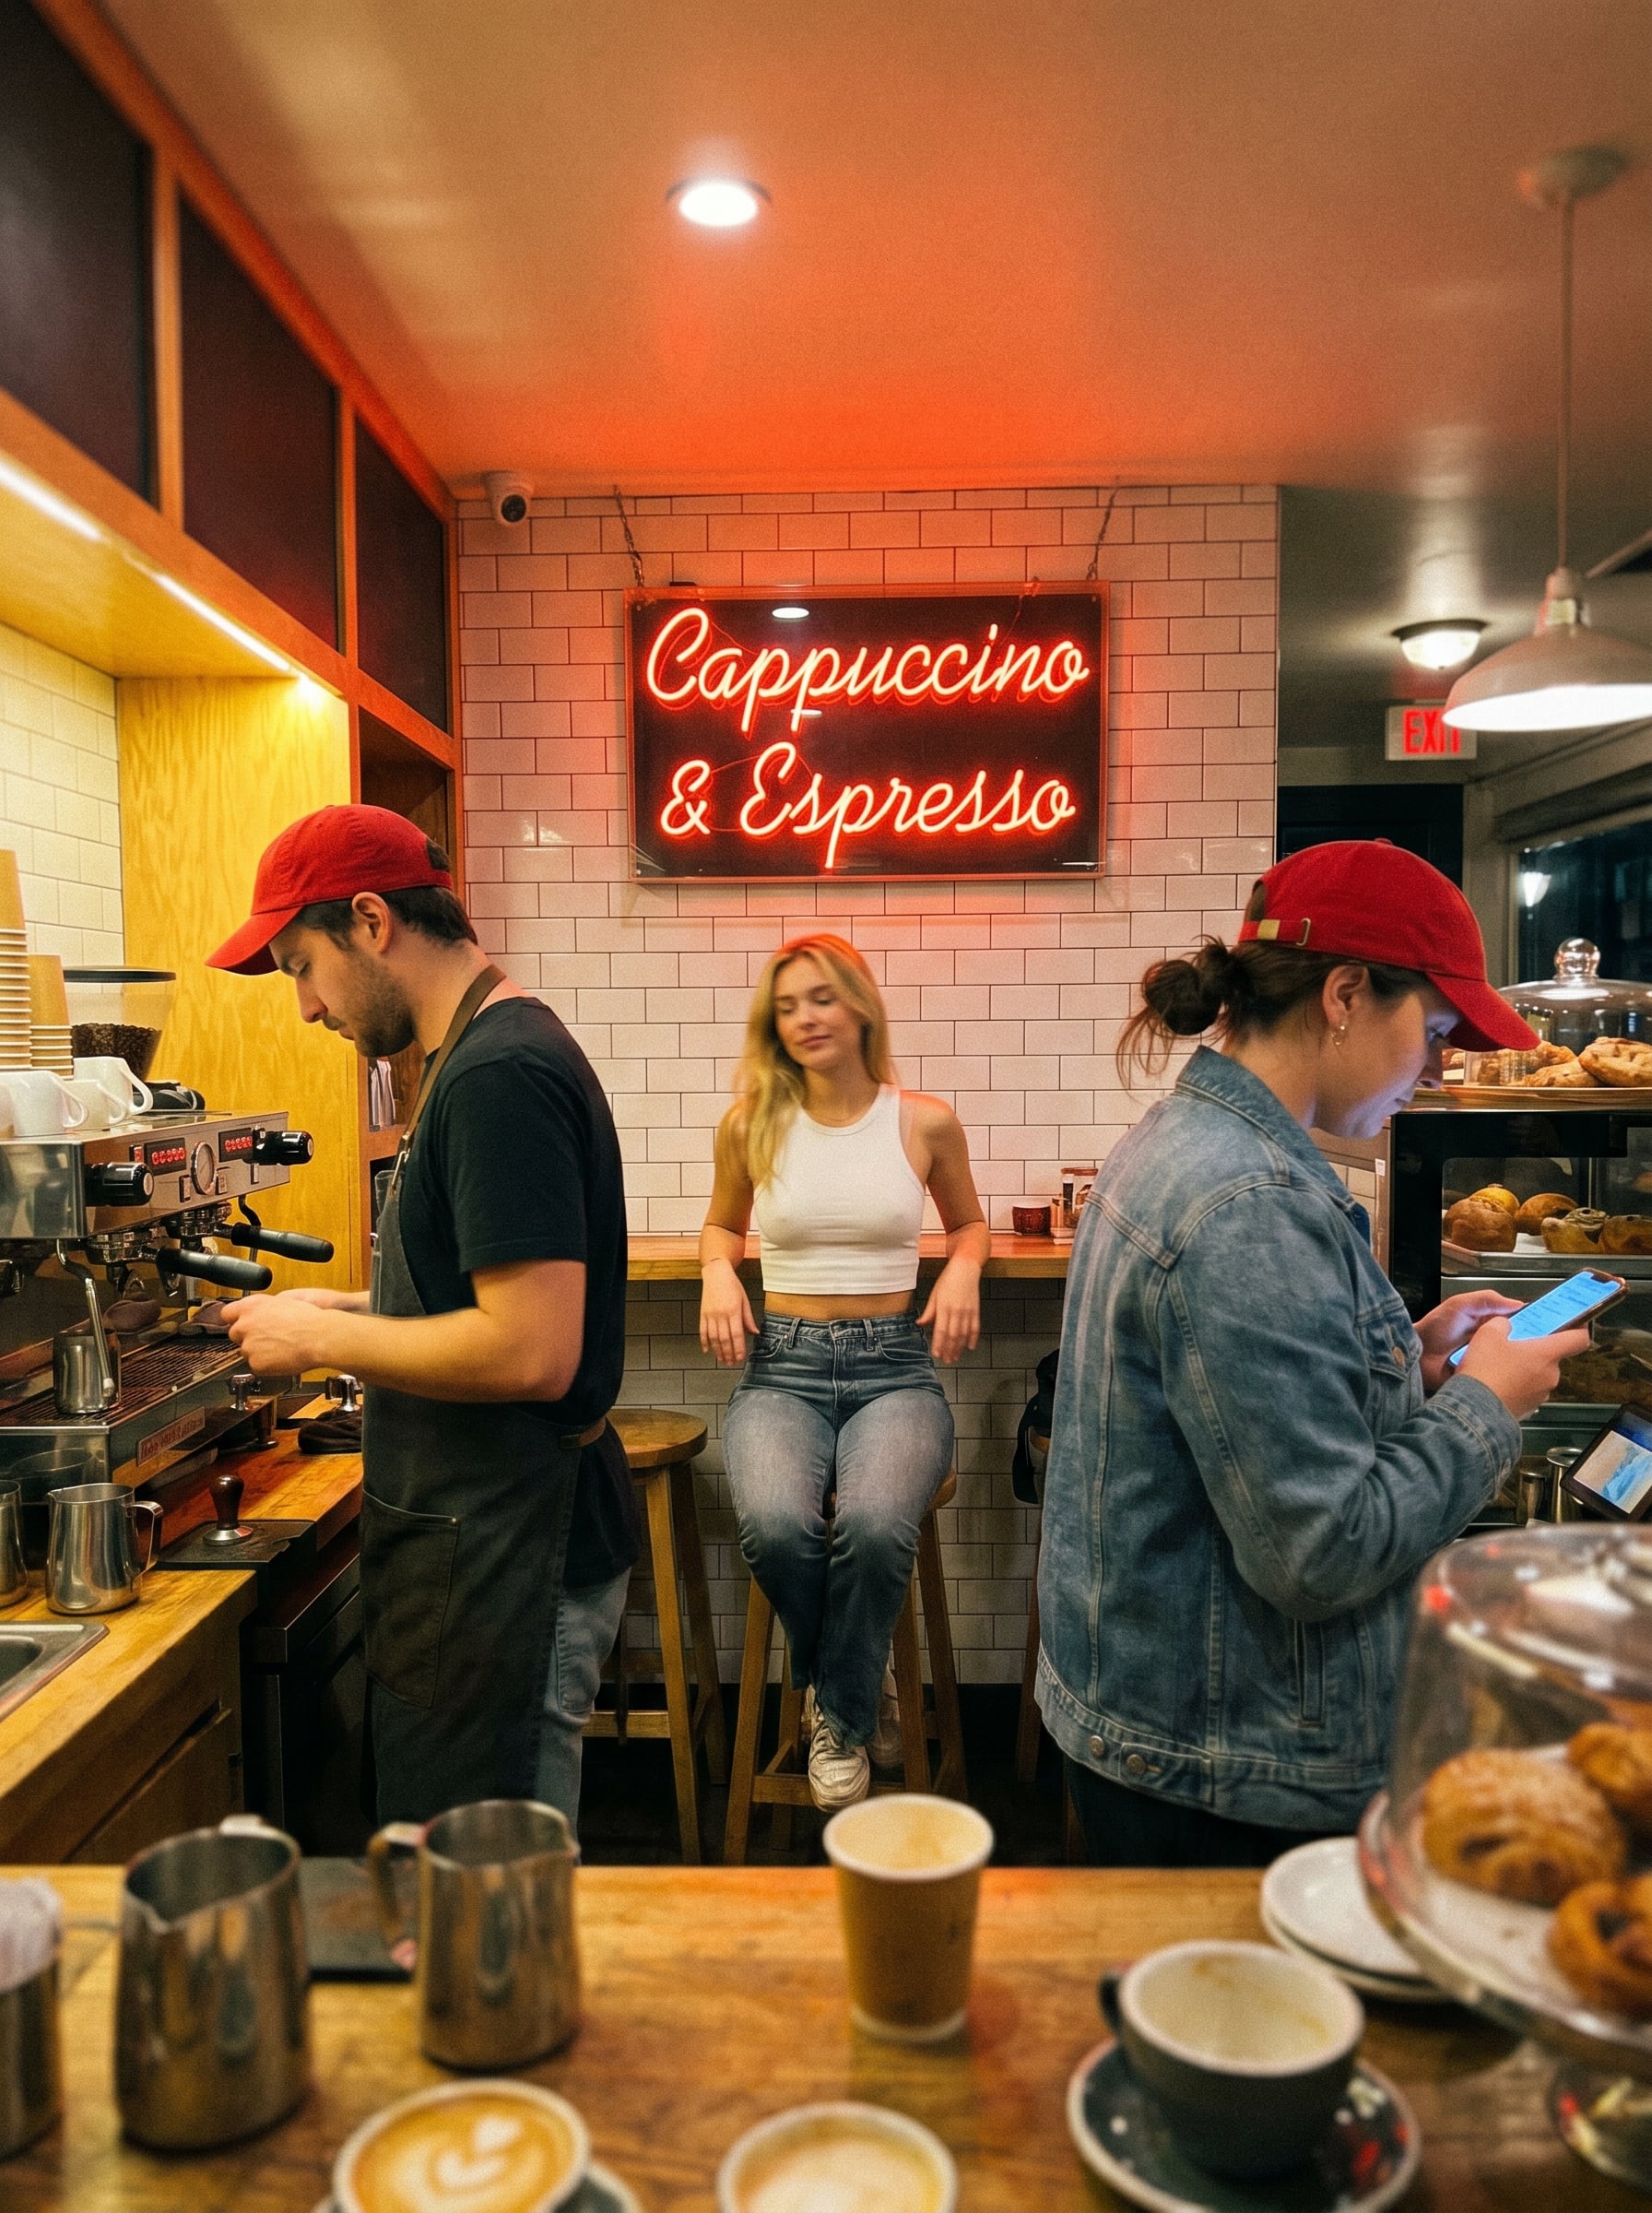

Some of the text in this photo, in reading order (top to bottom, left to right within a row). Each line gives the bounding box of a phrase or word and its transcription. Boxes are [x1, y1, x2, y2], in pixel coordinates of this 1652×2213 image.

[645, 607, 1091, 733] Cappuccino
[660, 741, 1077, 870] & Espresso
